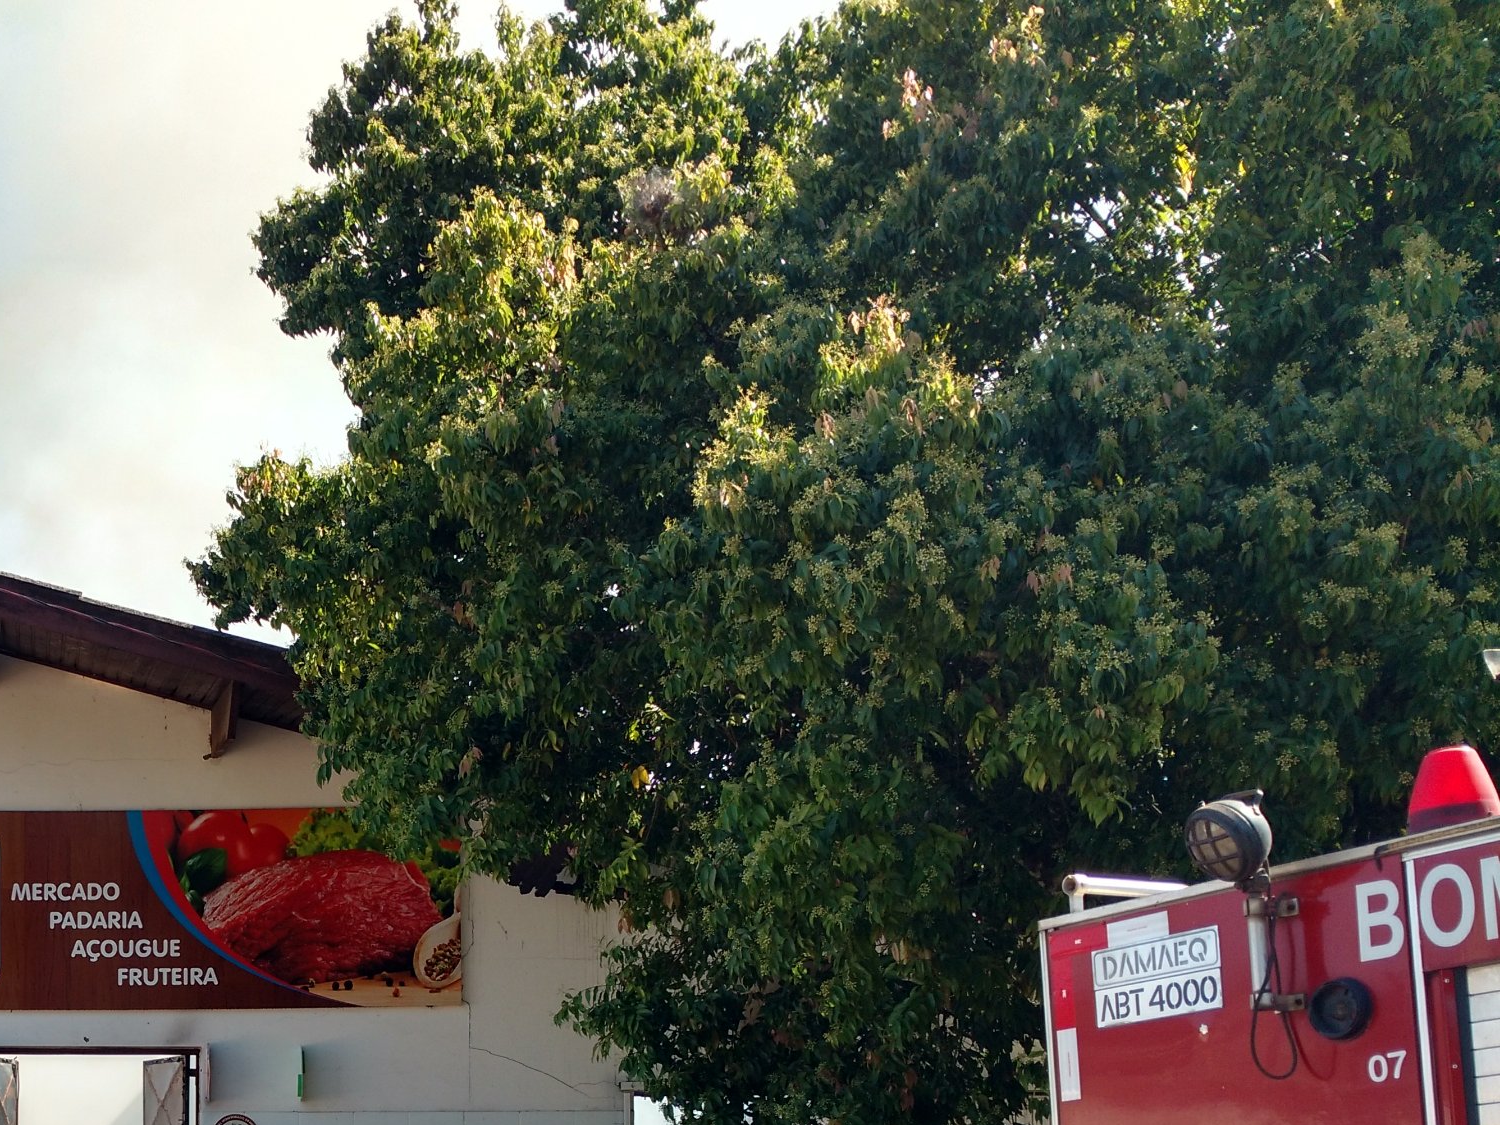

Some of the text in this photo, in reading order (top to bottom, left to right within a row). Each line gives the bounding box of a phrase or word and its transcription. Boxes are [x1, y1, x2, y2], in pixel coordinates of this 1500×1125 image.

[11, 882, 120, 901] MERCADO
[49, 911, 143, 930] PADARIA
[71, 939, 181, 962] AÇOUGUE
[1102, 937, 1208, 981] DAMAEQ
[117, 967, 218, 986] FRUTEIRA
[1101, 975, 1218, 1022] ABT 4000
[1367, 1050, 1407, 1083] 07
